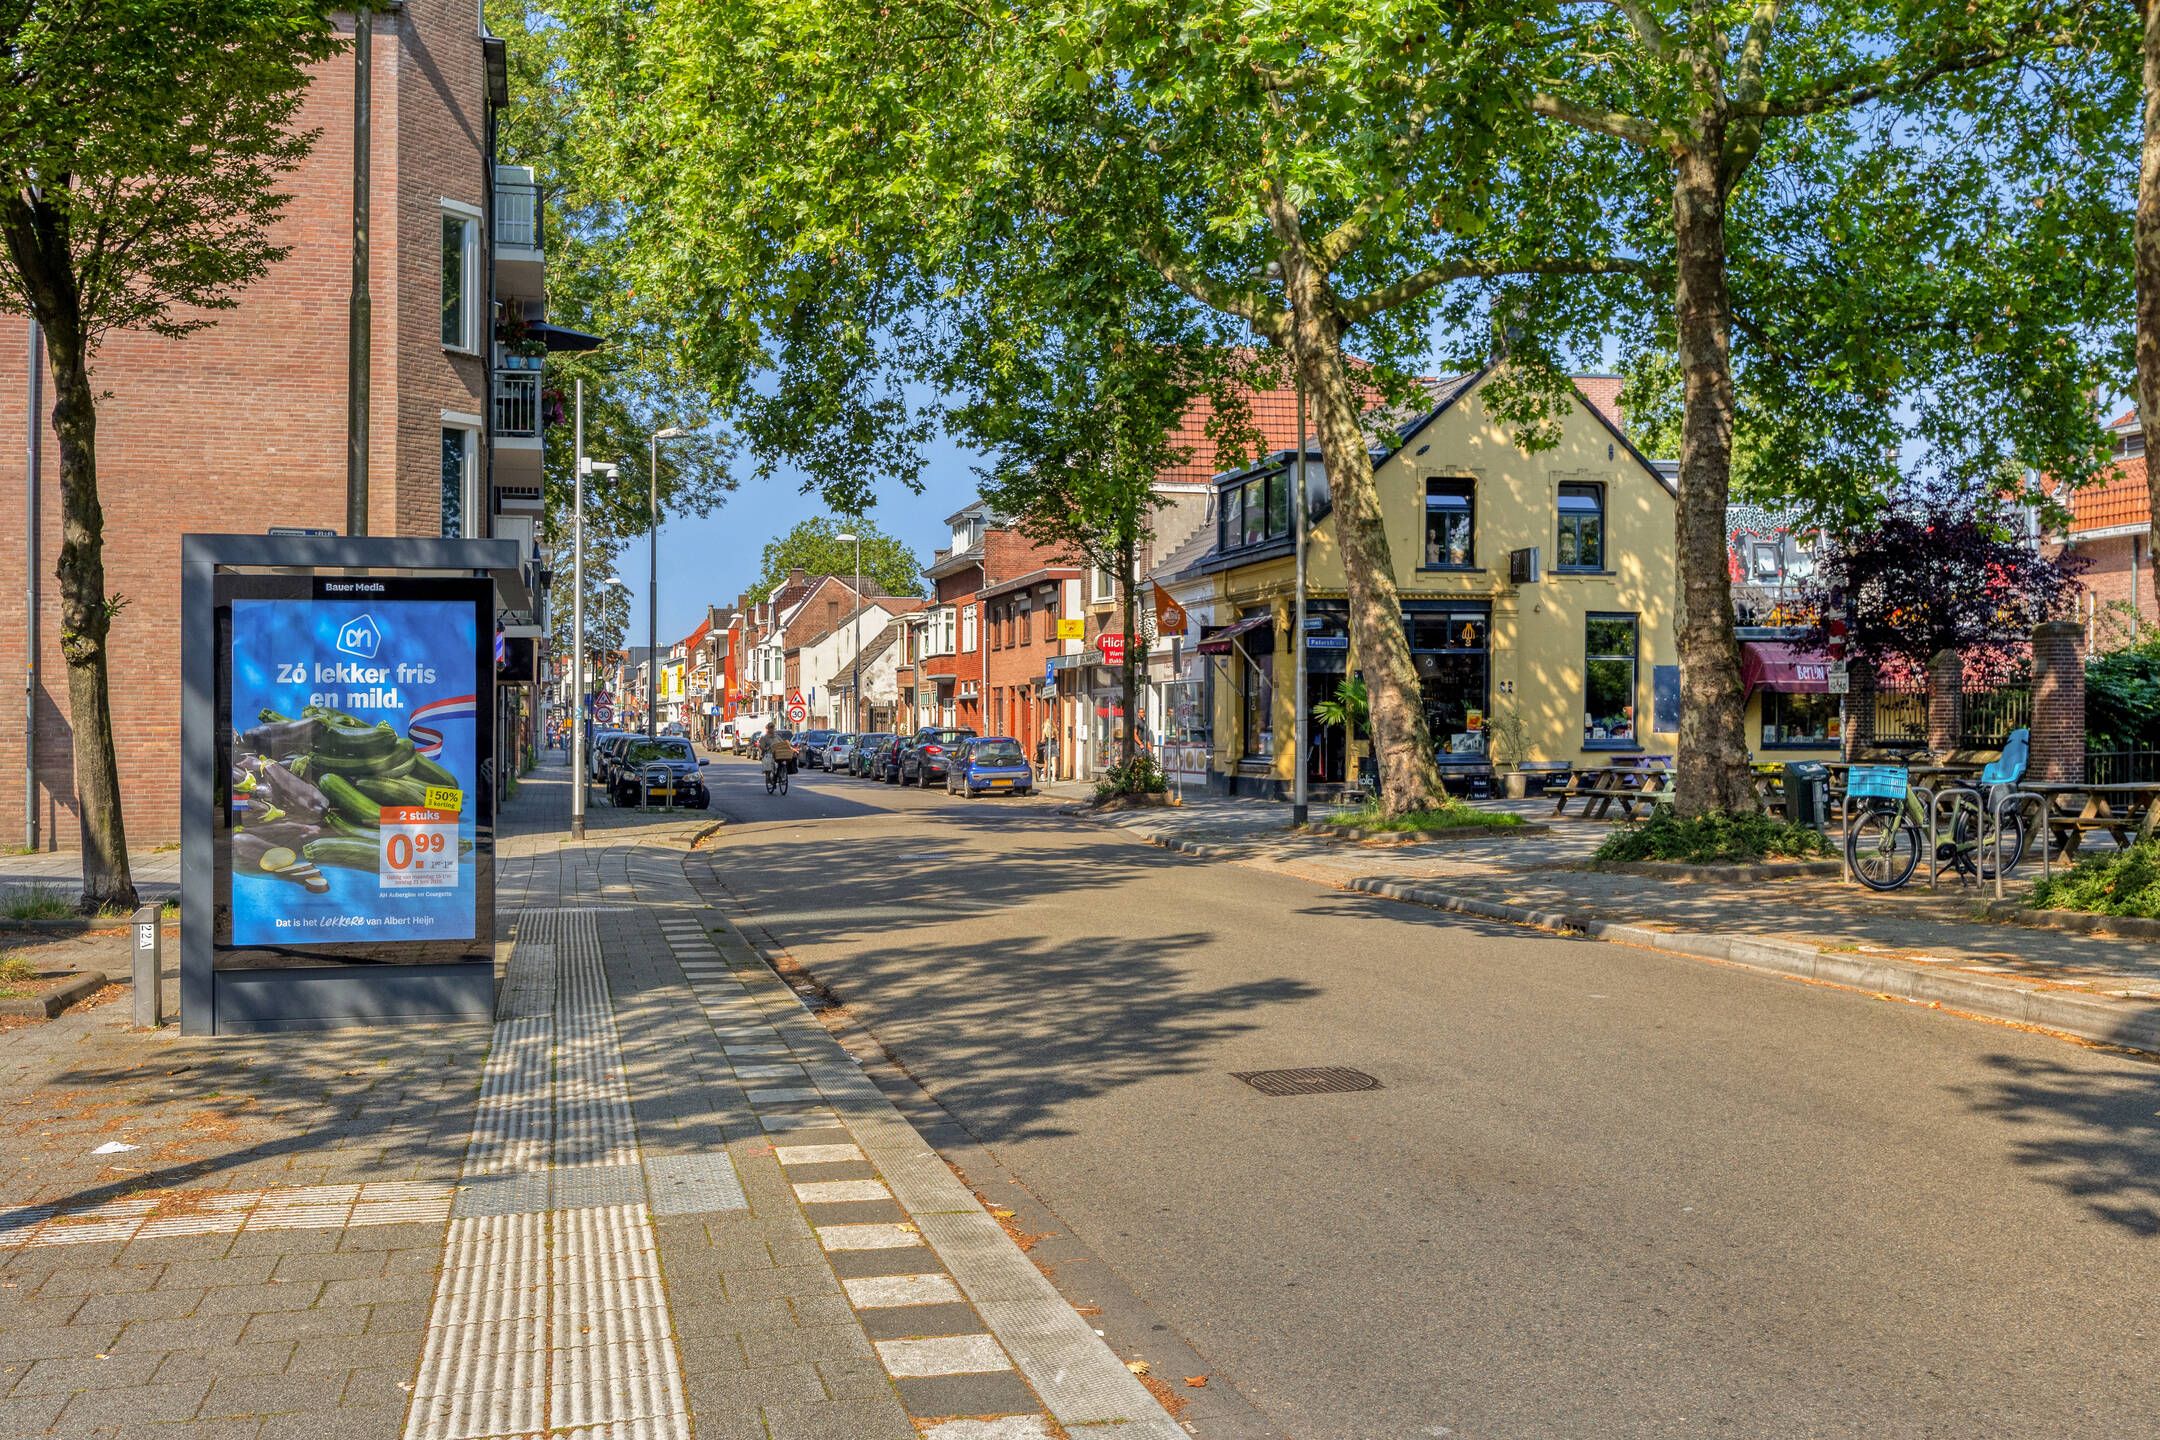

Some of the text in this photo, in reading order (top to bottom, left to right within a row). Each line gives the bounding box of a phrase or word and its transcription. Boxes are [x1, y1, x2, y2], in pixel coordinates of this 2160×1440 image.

[325, 583, 385, 591] Bauer Media
[276, 663, 436, 684] Zó lekker fris
[309, 688, 404, 708] en mild.
[599, 710, 609, 719] 30
[792, 710, 803, 719] 30
[434, 791, 458, 803] 50%
[433, 800, 455, 809] korting
[399, 811, 440, 820] 2 stuks
[386, 833, 445, 870] 0.99
[275, 919, 291, 927] Dat
[293, 918, 301, 926] is
[303, 918, 317, 927] het
[383, 915, 411, 925] Albert
[412, 915, 434, 926] Heijn
